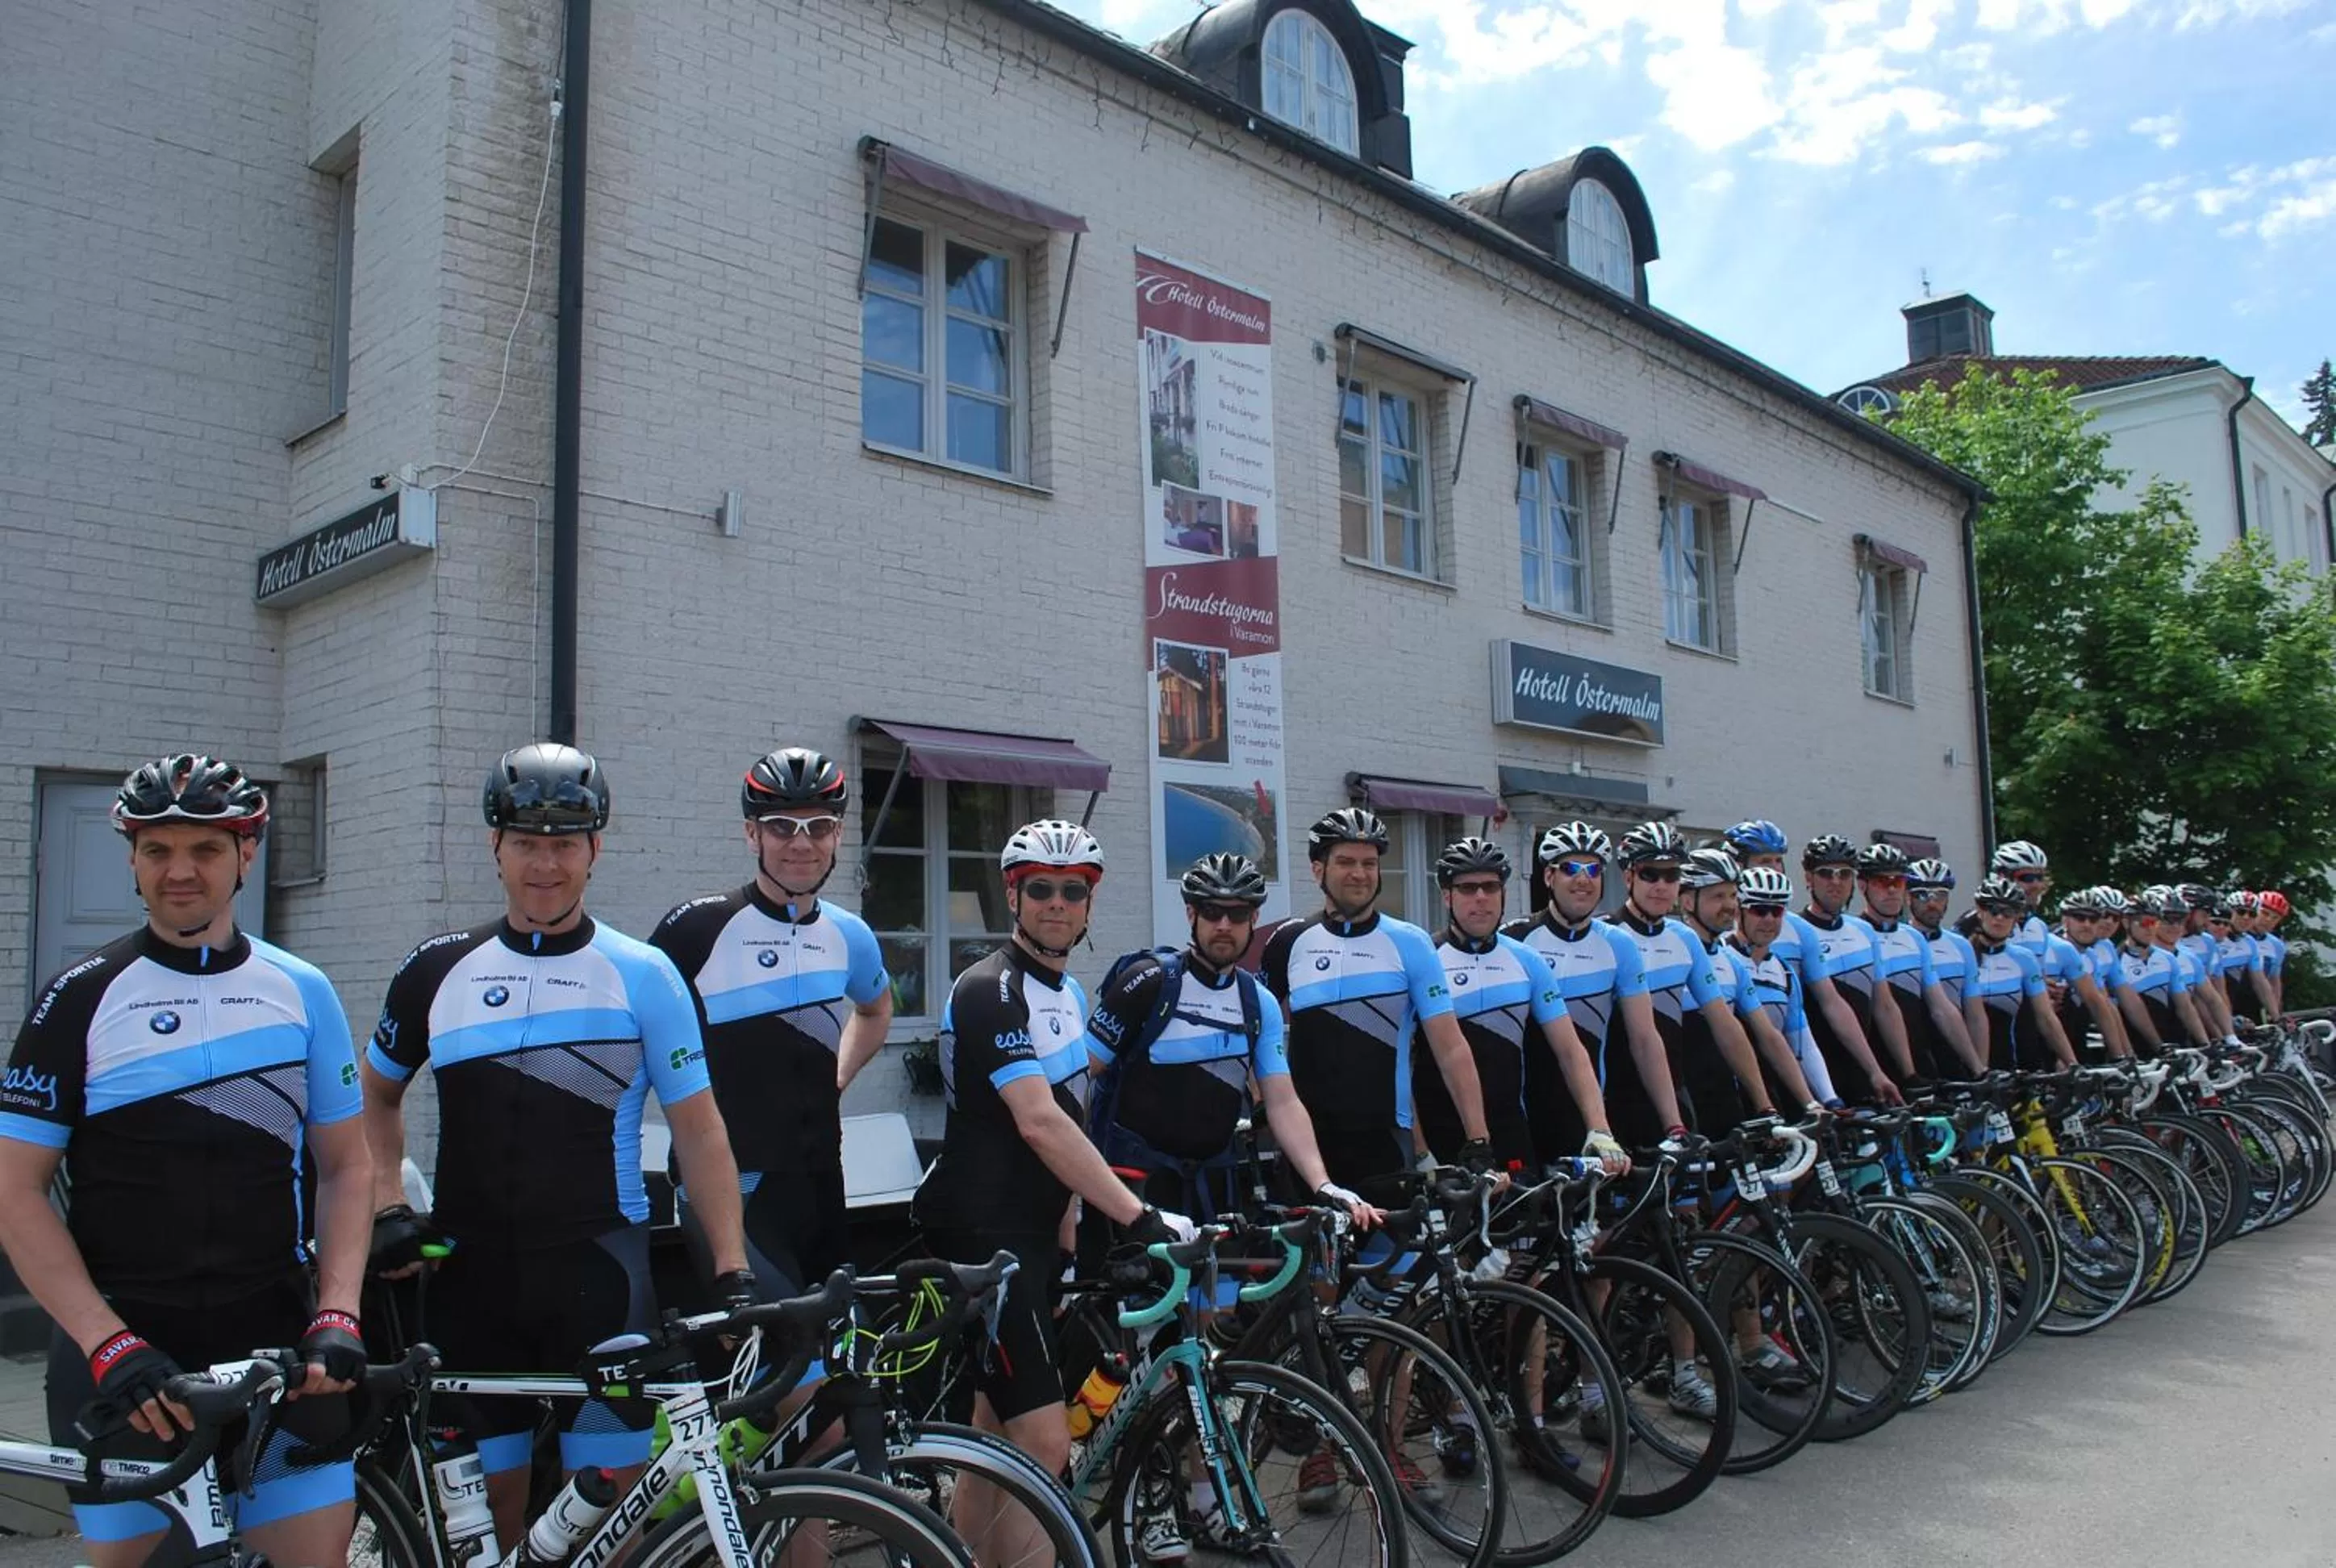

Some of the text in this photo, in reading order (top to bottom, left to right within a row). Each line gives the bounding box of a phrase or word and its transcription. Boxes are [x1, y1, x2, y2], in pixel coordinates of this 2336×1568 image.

[1168, 285, 1266, 332] Hotell Östermalm
[259, 507, 396, 597] Hotell Östermalm
[1146, 571, 1274, 626] Strandstugorna
[1516, 668, 1659, 721] Hotell Östermalm
[32, 955, 106, 1025] TEAM SPORTIA
[220, 997, 255, 1006] CRAFT
[995, 1028, 1032, 1049] eas
